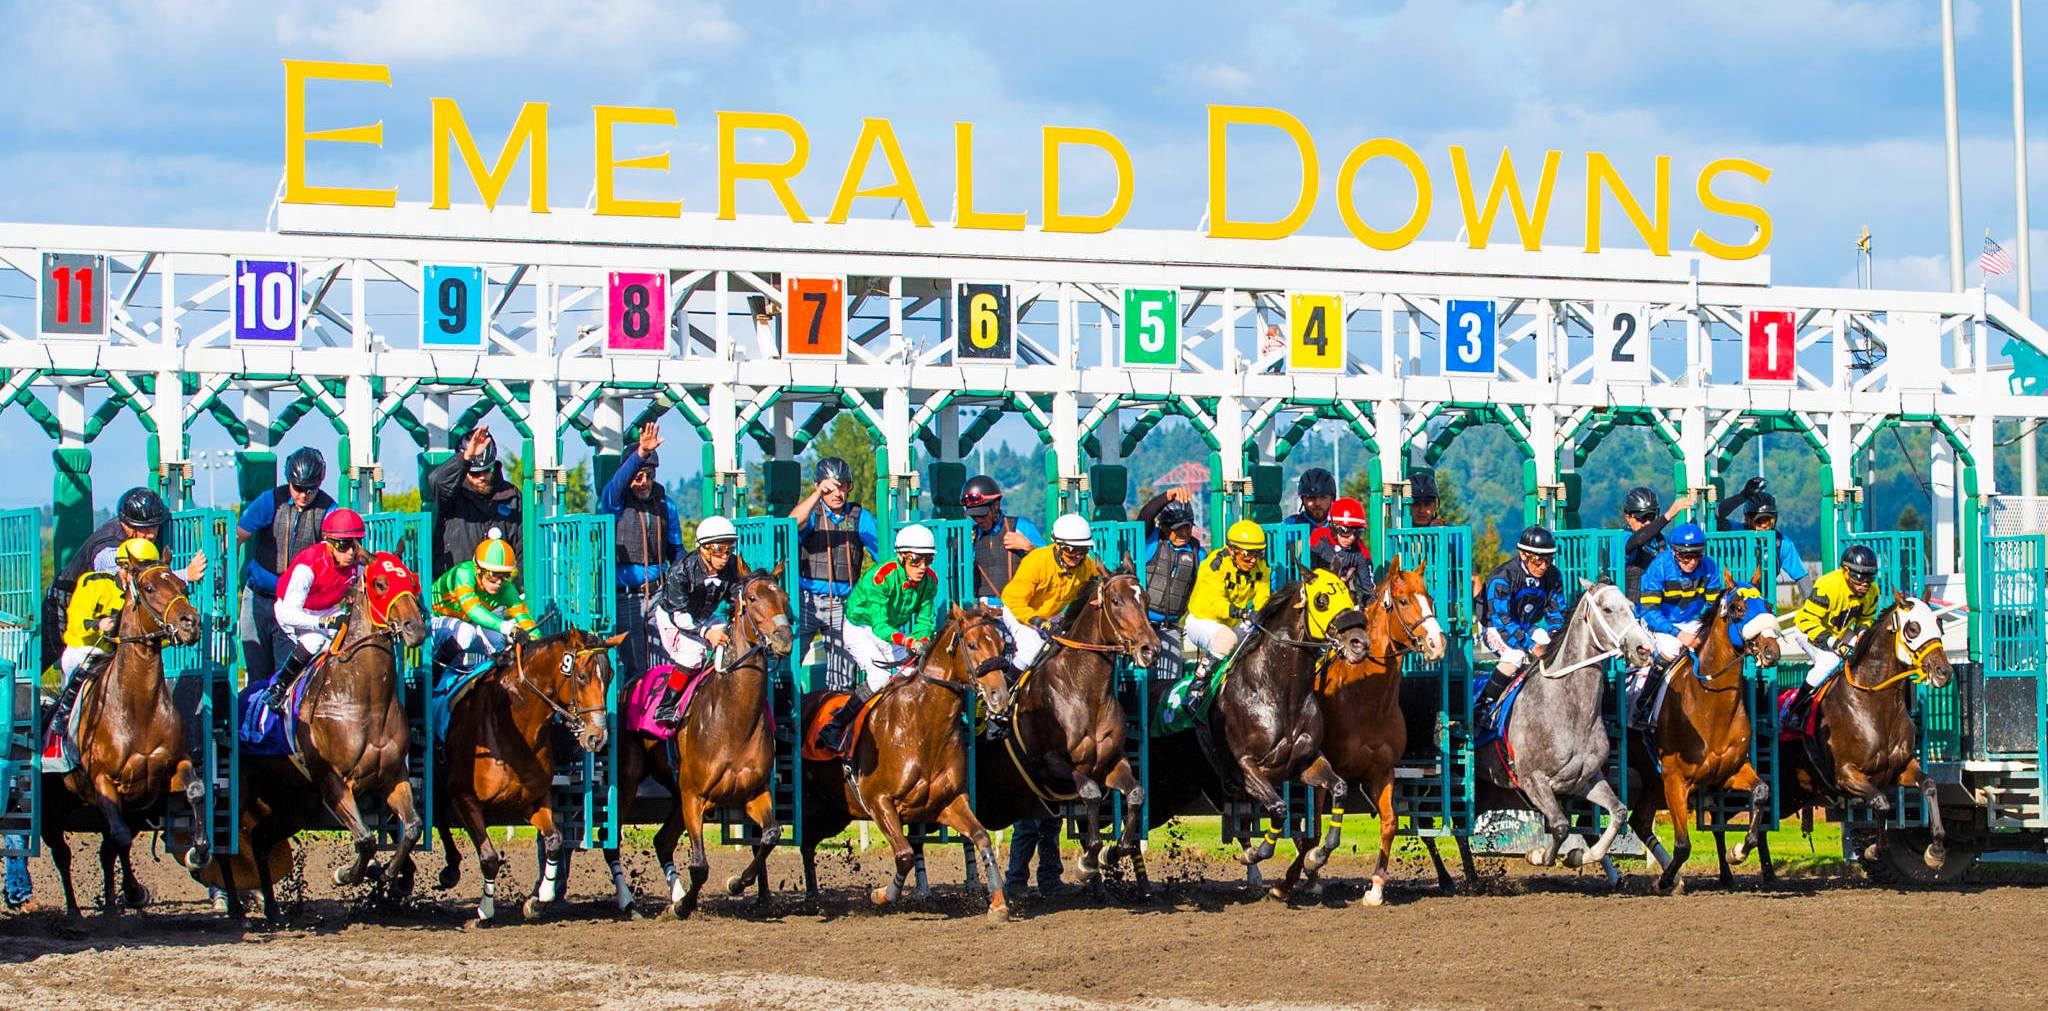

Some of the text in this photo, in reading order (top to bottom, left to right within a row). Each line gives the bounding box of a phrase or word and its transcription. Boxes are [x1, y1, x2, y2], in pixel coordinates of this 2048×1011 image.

[284, 60, 1772, 260] EMERALD DOWNS
[53, 267, 92, 324] 11
[237, 270, 293, 330] 10
[439, 279, 467, 334] 9
[622, 285, 650, 339] 8
[803, 294, 826, 344] 7
[971, 294, 998, 349] 6
[1139, 301, 1165, 353] 5
[1303, 307, 1327, 356] 4
[1458, 313, 1482, 363] 3
[1612, 313, 1636, 362] 2
[1764, 322, 1778, 371] 1
[561, 654, 573, 673] 9
